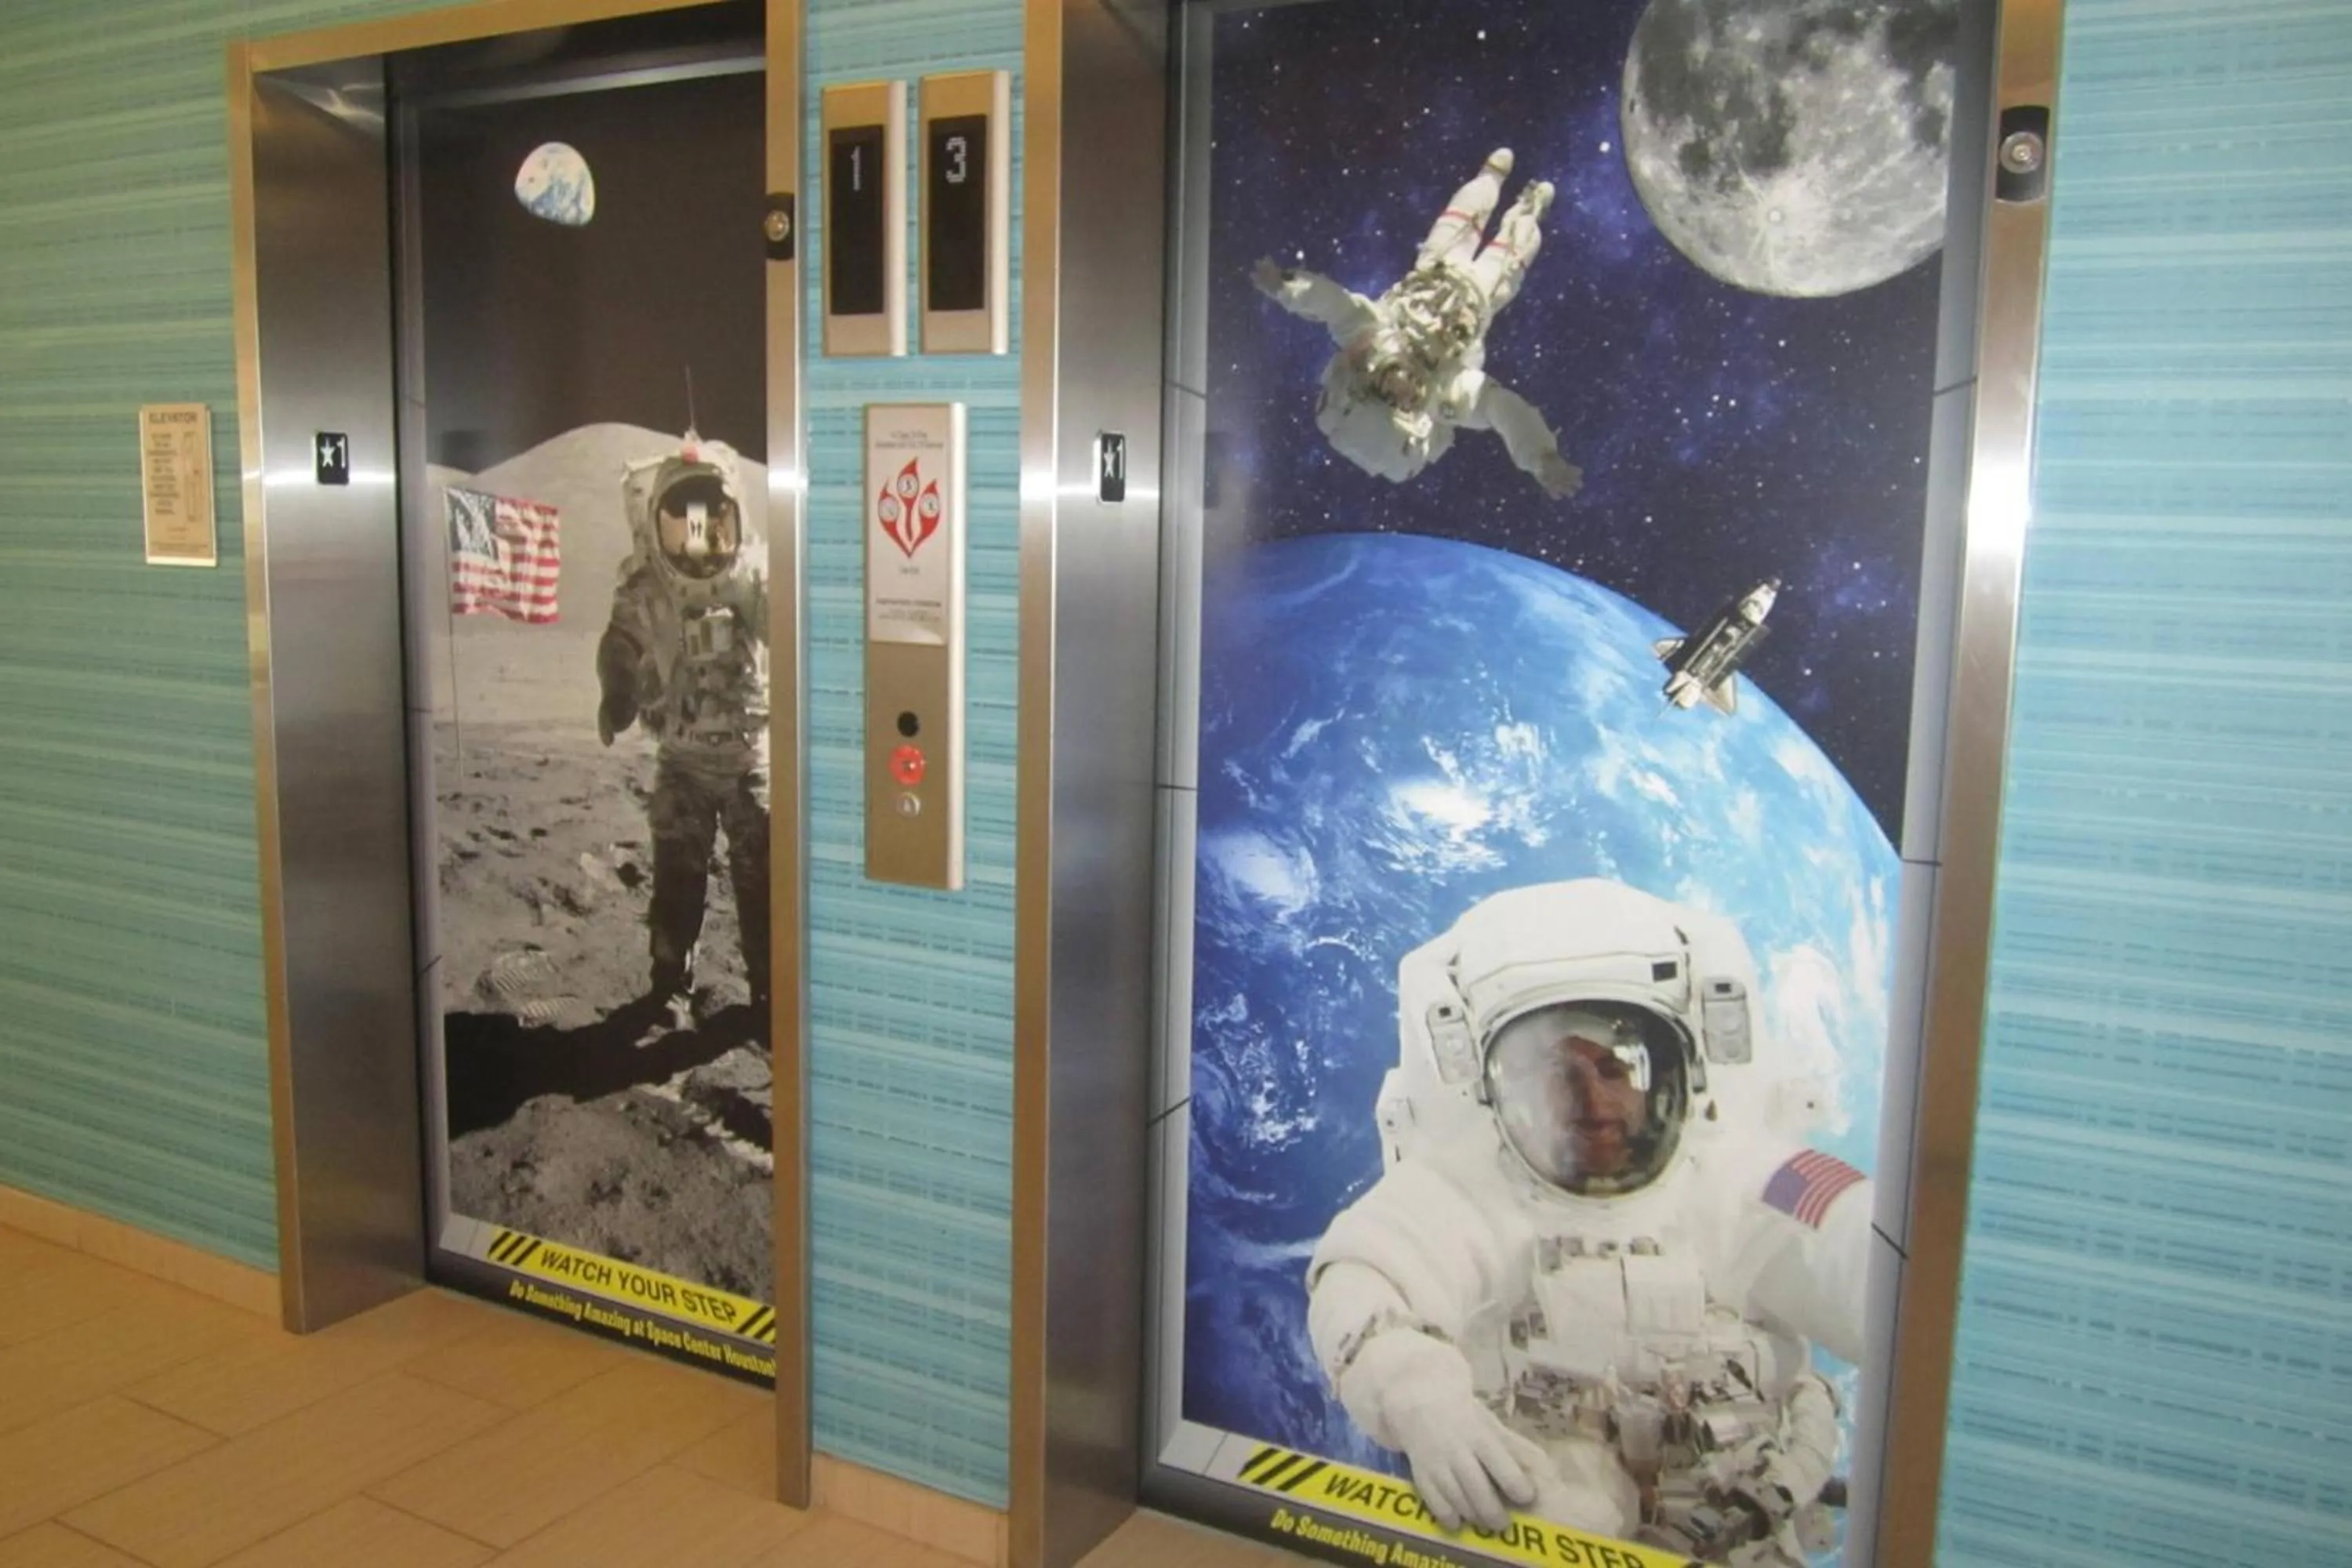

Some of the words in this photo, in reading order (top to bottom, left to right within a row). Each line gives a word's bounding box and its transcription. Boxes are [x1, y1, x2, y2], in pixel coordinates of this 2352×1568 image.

[851, 145, 861, 191] 1
[946, 136, 967, 183] 3
[336, 436, 347, 470] 1
[1116, 438, 1124, 480] 1
[540, 1249, 612, 1286] WATCH
[617, 1270, 678, 1307] YOUR
[680, 1288, 737, 1323] STEP
[525, 1283, 583, 1322] Something
[583, 1301, 632, 1336] Amazing
[632, 1319, 645, 1337] at
[646, 1319, 683, 1347] Space
[682, 1330, 722, 1360] Center
[1269, 1508, 1294, 1533] Do
[1296, 1515, 1389, 1565] Something
